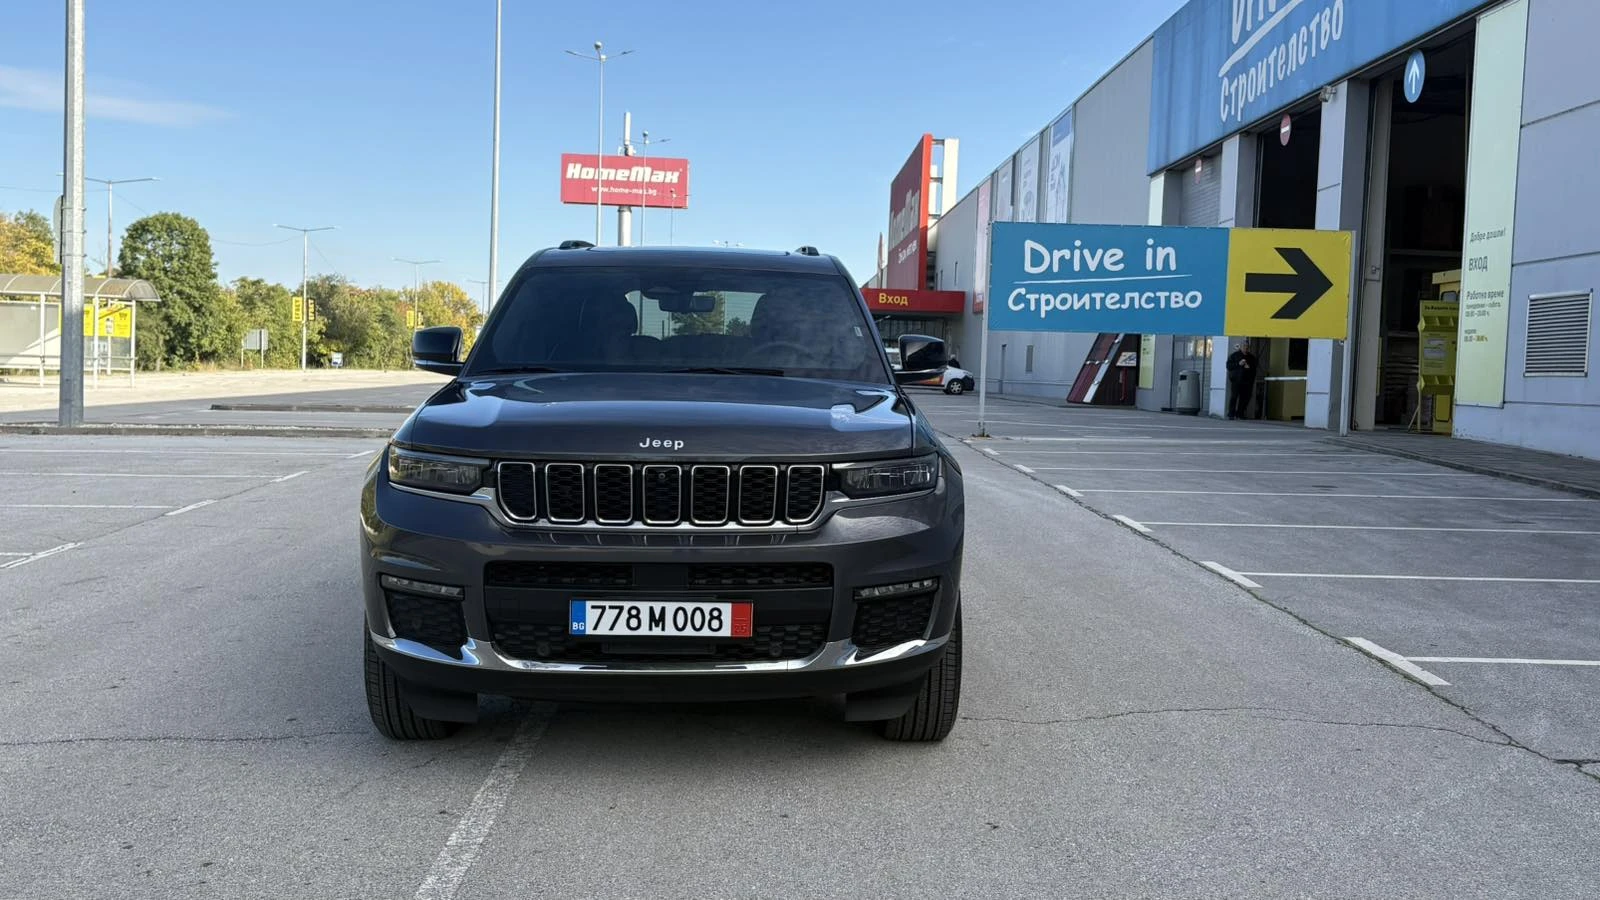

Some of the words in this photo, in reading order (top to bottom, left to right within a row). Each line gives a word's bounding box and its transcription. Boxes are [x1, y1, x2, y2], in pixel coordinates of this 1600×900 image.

[1220, 0, 1344, 122] Строителство
[566, 163, 680, 184] HomeMax
[1024, 239, 1125, 274] Drive
[1145, 238, 1177, 271] in
[1468, 256, 1488, 272] ВХОД
[878, 292, 909, 306] Вход
[1007, 287, 1203, 319] Строителство
[639, 437, 684, 451] Jeep
[572, 622, 585, 630] BG
[590, 605, 642, 631] 778
[672, 606, 724, 632] 008
